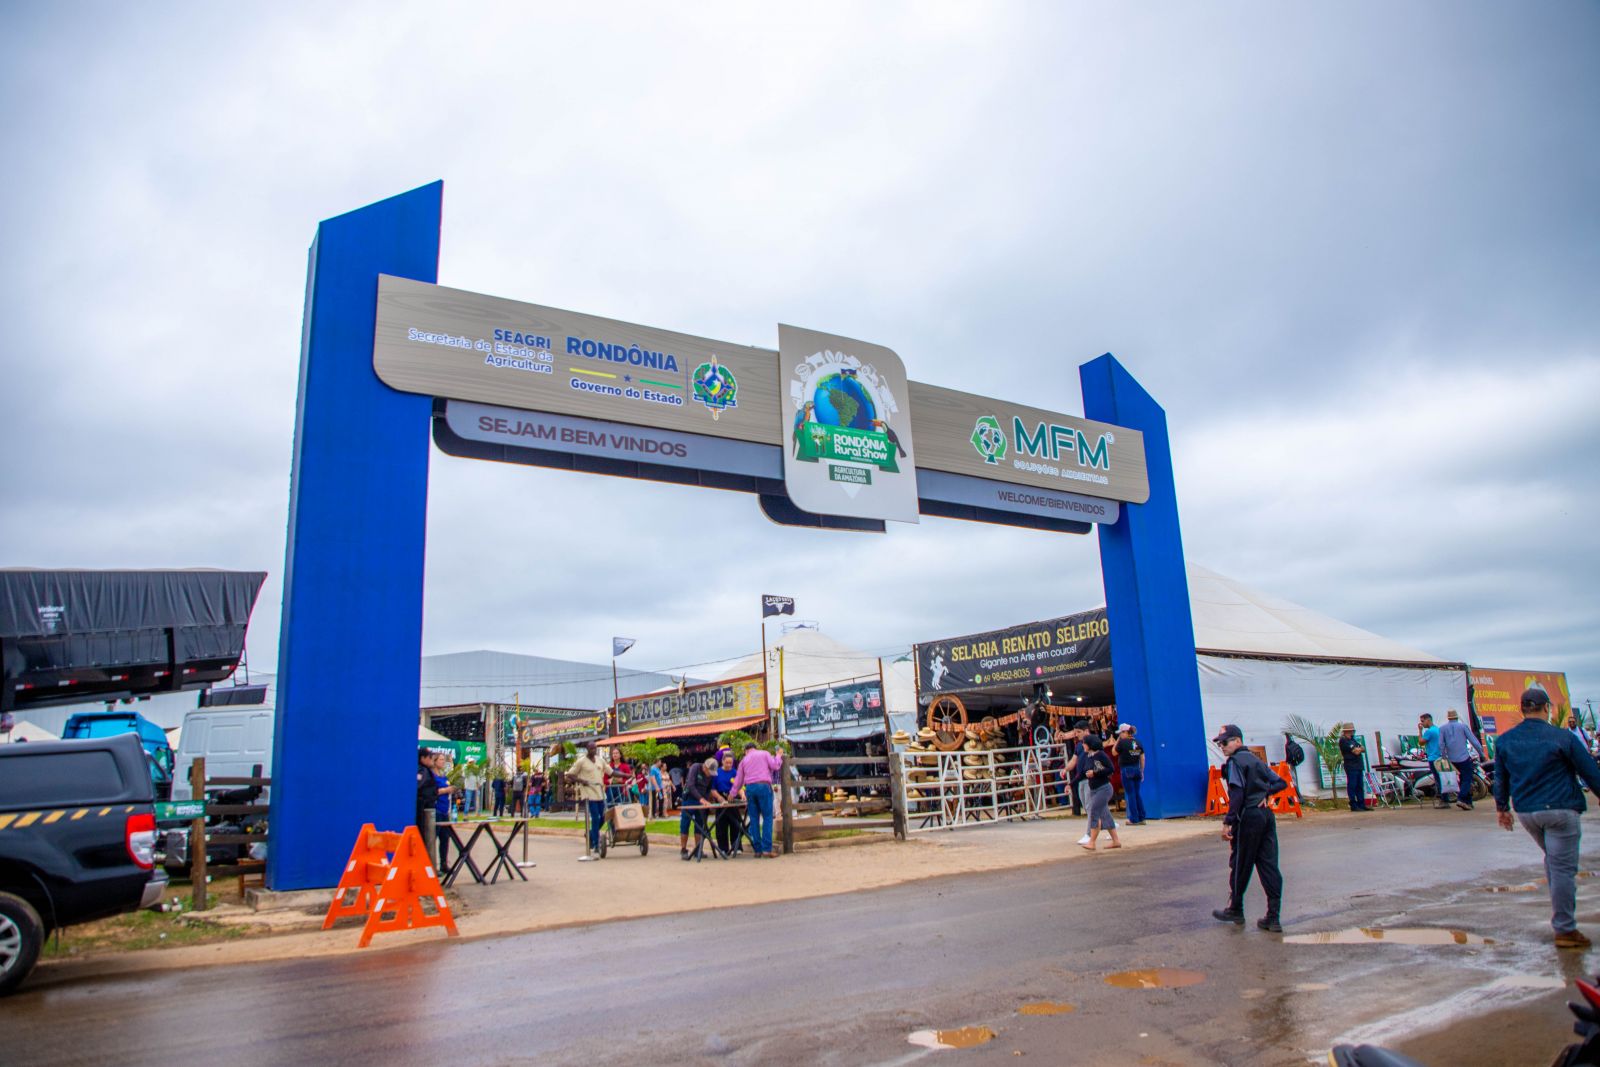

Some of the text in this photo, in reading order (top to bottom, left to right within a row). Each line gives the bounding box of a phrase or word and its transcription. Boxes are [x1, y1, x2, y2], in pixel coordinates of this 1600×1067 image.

[408, 328, 553, 362] Secretaria de Estado da
[494, 329, 551, 350] SEAGRI
[485, 354, 553, 374] Agricultura
[566, 336, 679, 373] RONDÔNIA
[570, 378, 683, 406] Governo do Estado
[478, 416, 688, 458] SEJAM BEM VINDOS
[833, 433, 888, 452] RONDÔNIA
[1013, 416, 1110, 471] MFM
[834, 443, 862, 457] Rural
[862, 447, 888, 461] Show
[834, 465, 866, 477] AGRICULTURA
[997, 490, 1105, 516] WELCOME/BIENVENIDOS
[951, 618, 1109, 662] SELARIA RENATO SELEIRO
[980, 644, 1077, 669] Gigante na Arte em couros!
[983, 673, 991, 683] 69
[991, 667, 1031, 681] 98452-8035
